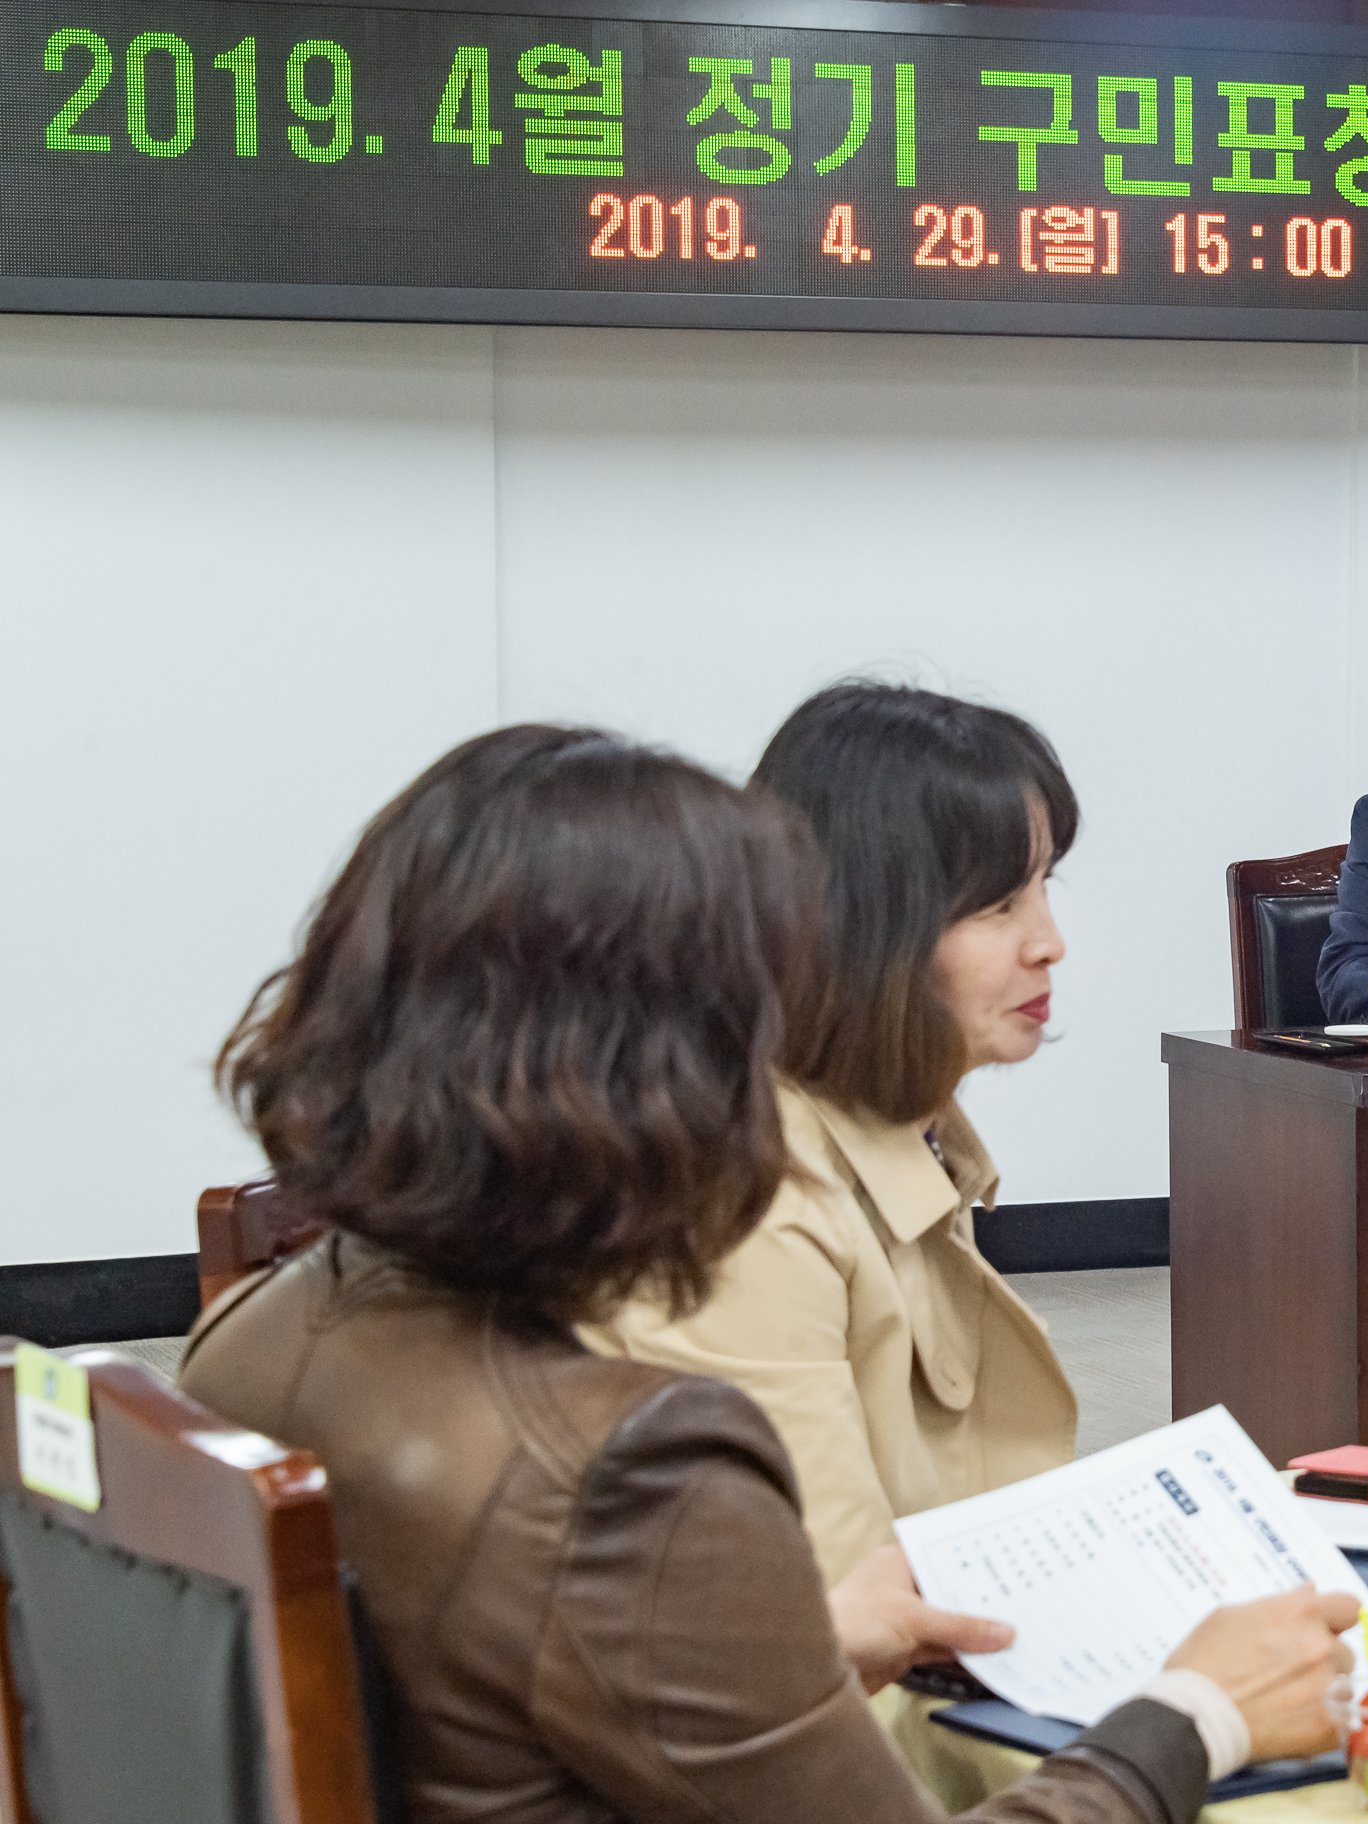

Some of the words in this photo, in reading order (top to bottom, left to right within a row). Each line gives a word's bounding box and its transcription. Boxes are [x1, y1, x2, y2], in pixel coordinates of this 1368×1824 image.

[43, 27, 383, 164] 2019.
[432, 42, 624, 177] 4월
[685, 56, 916, 188] 정기
[588, 193, 757, 262] 2019.
[821, 203, 872, 264] 4.
